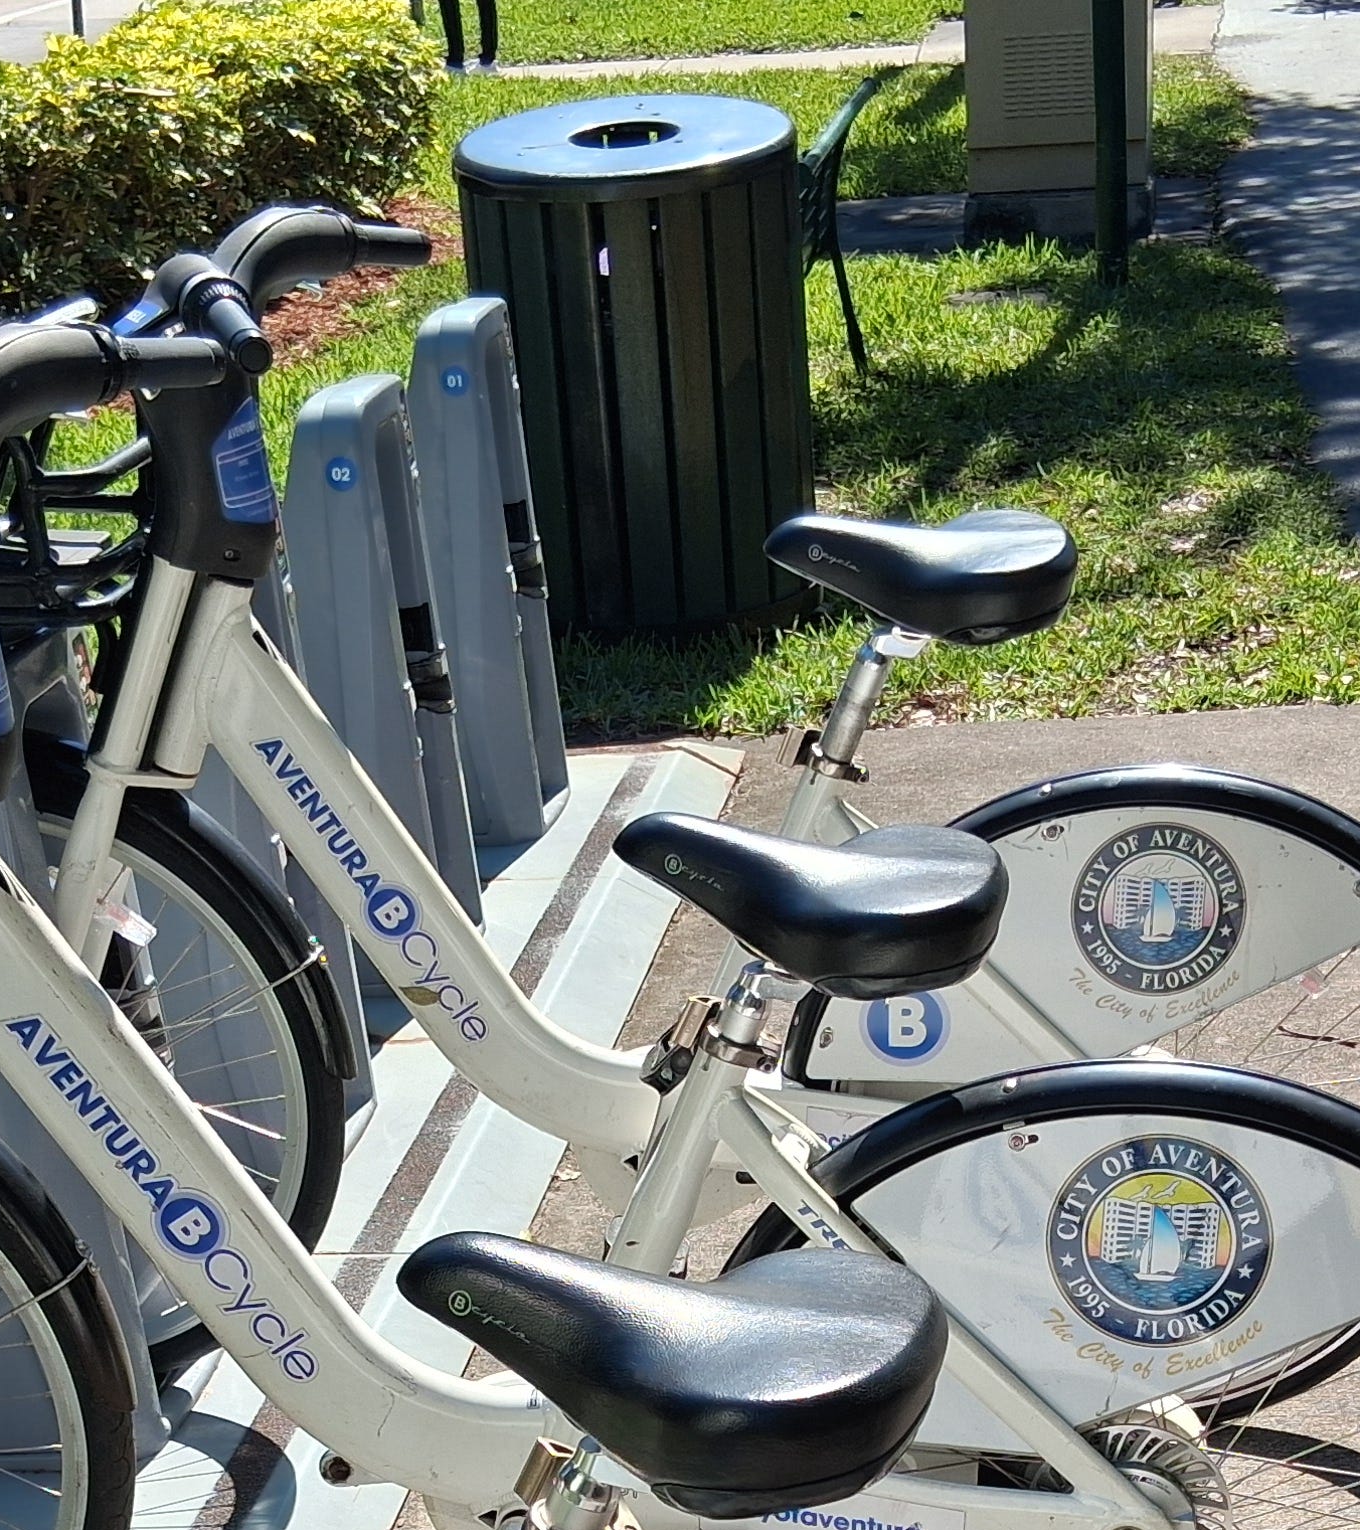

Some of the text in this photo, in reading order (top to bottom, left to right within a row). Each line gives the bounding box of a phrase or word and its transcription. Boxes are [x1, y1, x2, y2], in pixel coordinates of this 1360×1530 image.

[446, 375, 463, 389] 01
[330, 467, 351, 482] 02
[1078, 828, 1240, 915] CITY OF AVENTURA
[1086, 939, 1123, 975] 1995
[1140, 944, 1227, 990] FLORIDA
[1068, 967, 1241, 1024] The City of Excellence
[1056, 1143, 1264, 1252] CITY OF AVENTURA
[1065, 1275, 1112, 1319] 1995
[1134, 1288, 1247, 1340] FLORIDA
[1042, 1307, 1265, 1380] The City of Excellence
